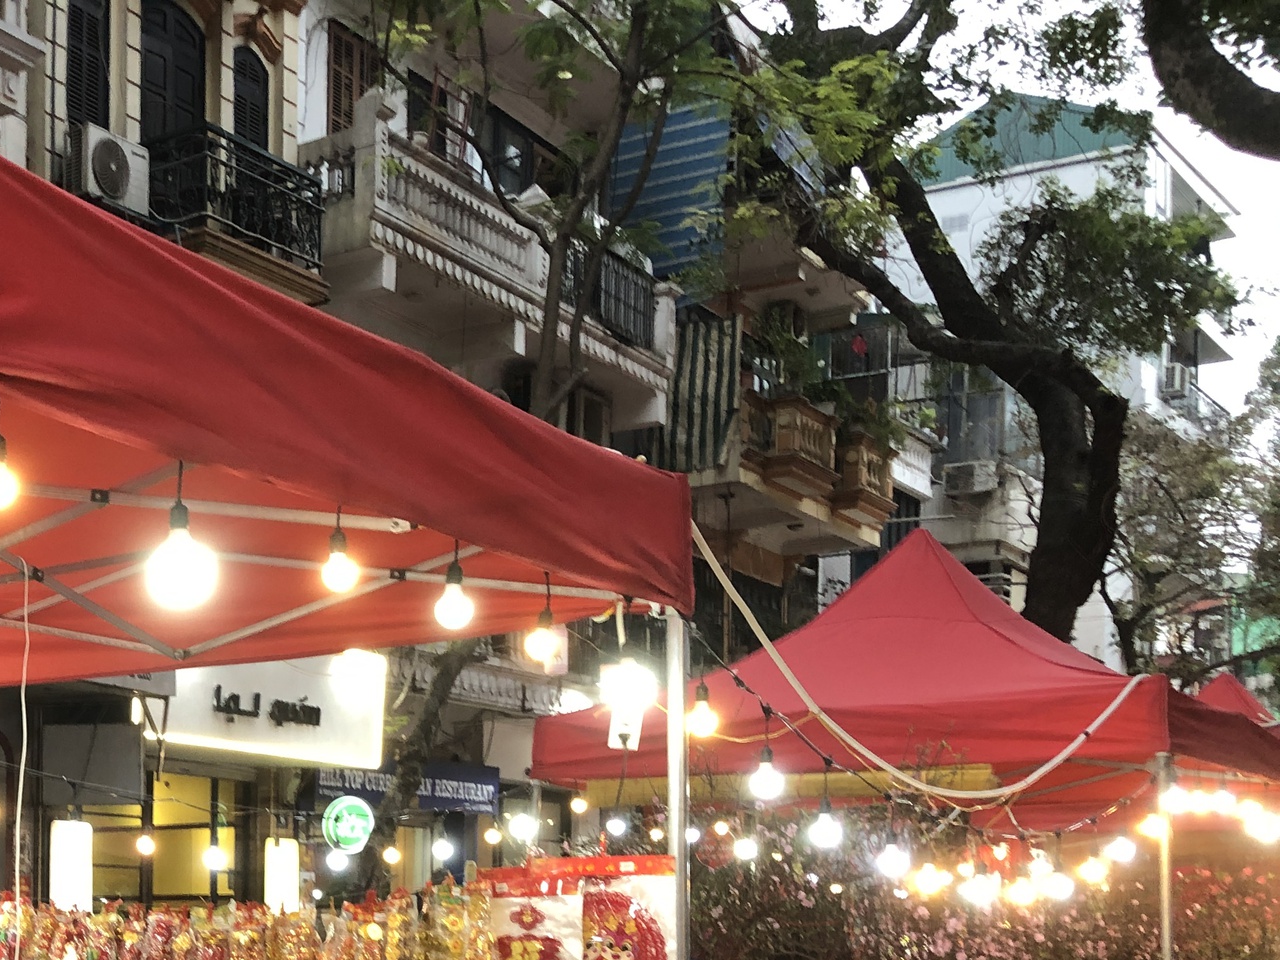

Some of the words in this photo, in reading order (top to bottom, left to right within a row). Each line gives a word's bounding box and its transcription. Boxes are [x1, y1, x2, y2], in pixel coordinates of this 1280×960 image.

[319, 768, 343, 787] HILL
[344, 769, 363, 790] TOP
[434, 779, 495, 804] RESTAURANT
